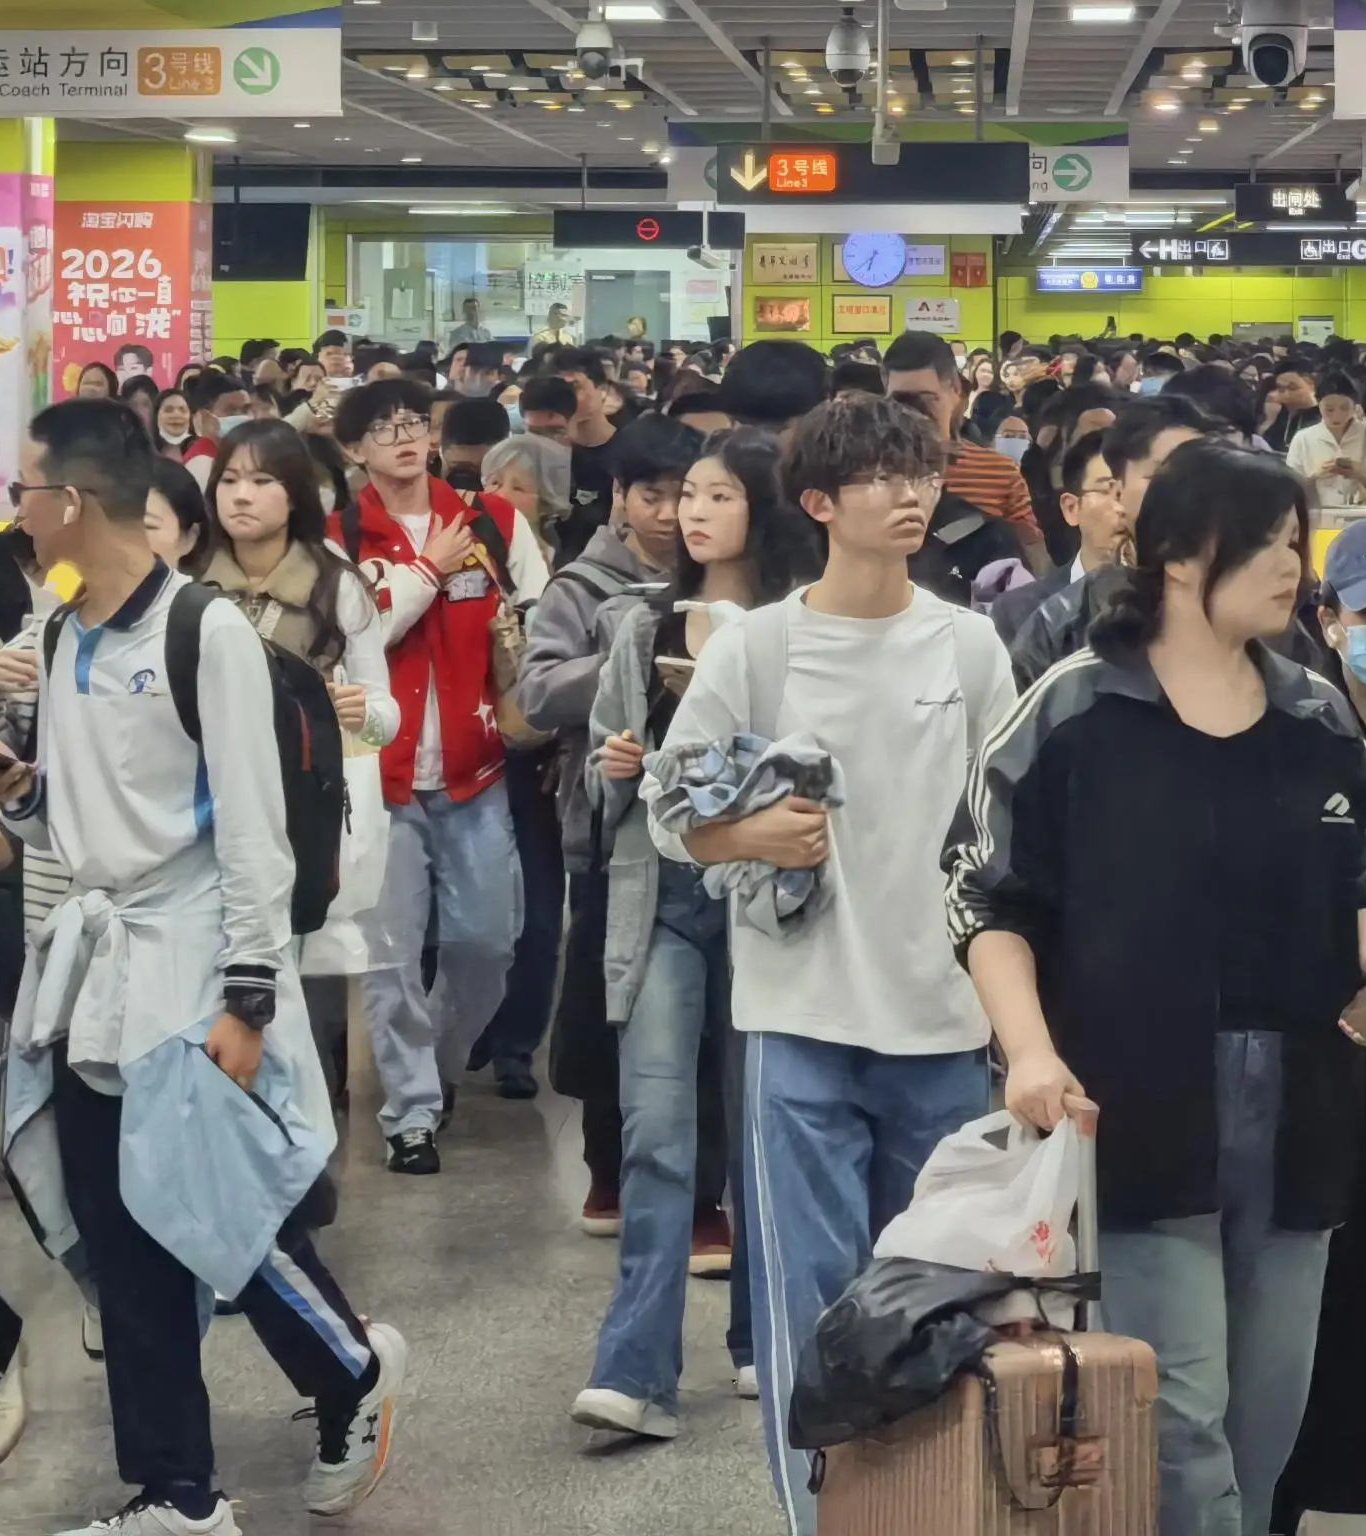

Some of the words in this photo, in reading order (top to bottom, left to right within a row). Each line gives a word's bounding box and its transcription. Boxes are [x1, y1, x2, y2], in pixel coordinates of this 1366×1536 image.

[144, 49, 215, 90] 3号线
[58, 83, 129, 99] Terminal
[777, 159, 828, 176] 3号线
[82, 212, 154, 229] 淘宝闪购
[1160, 239, 1177, 260] H
[61, 248, 162, 279] 2026
